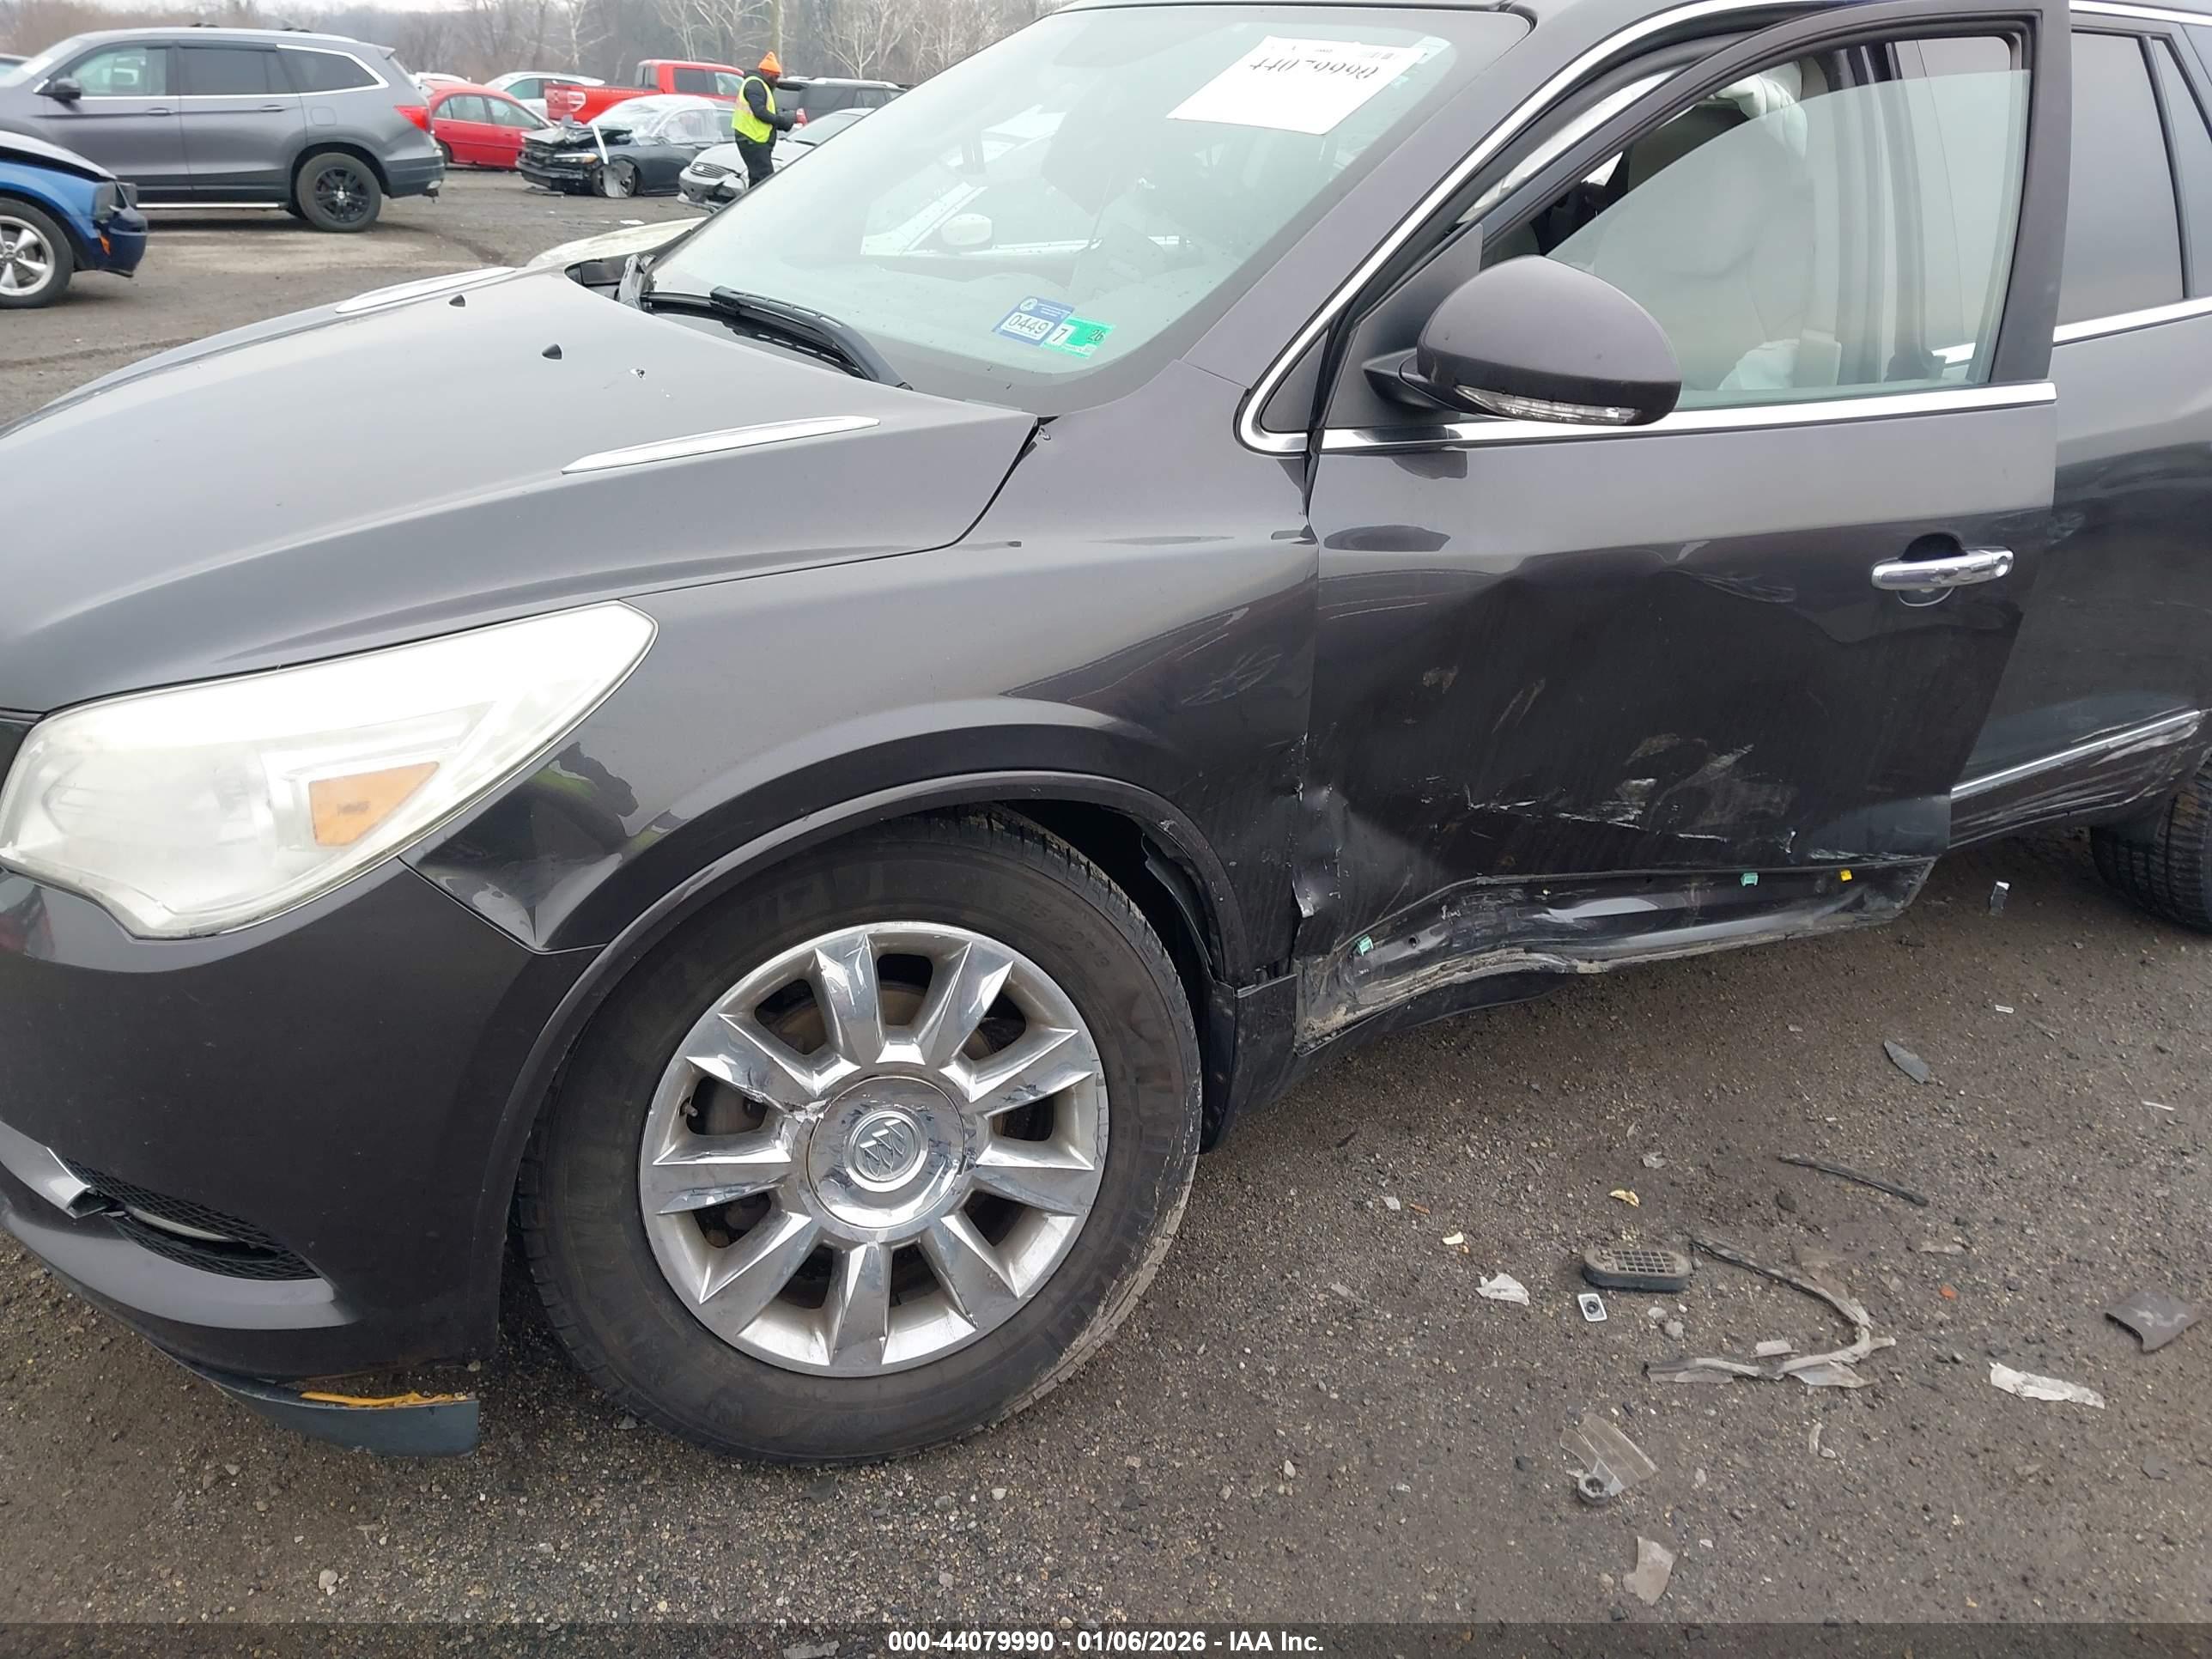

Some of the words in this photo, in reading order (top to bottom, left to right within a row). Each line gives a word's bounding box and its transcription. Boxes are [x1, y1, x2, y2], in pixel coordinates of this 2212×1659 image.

[1007, 313, 1049, 335] 0449
[1052, 327, 1068, 343] 7
[1088, 328, 1106, 343] 26
